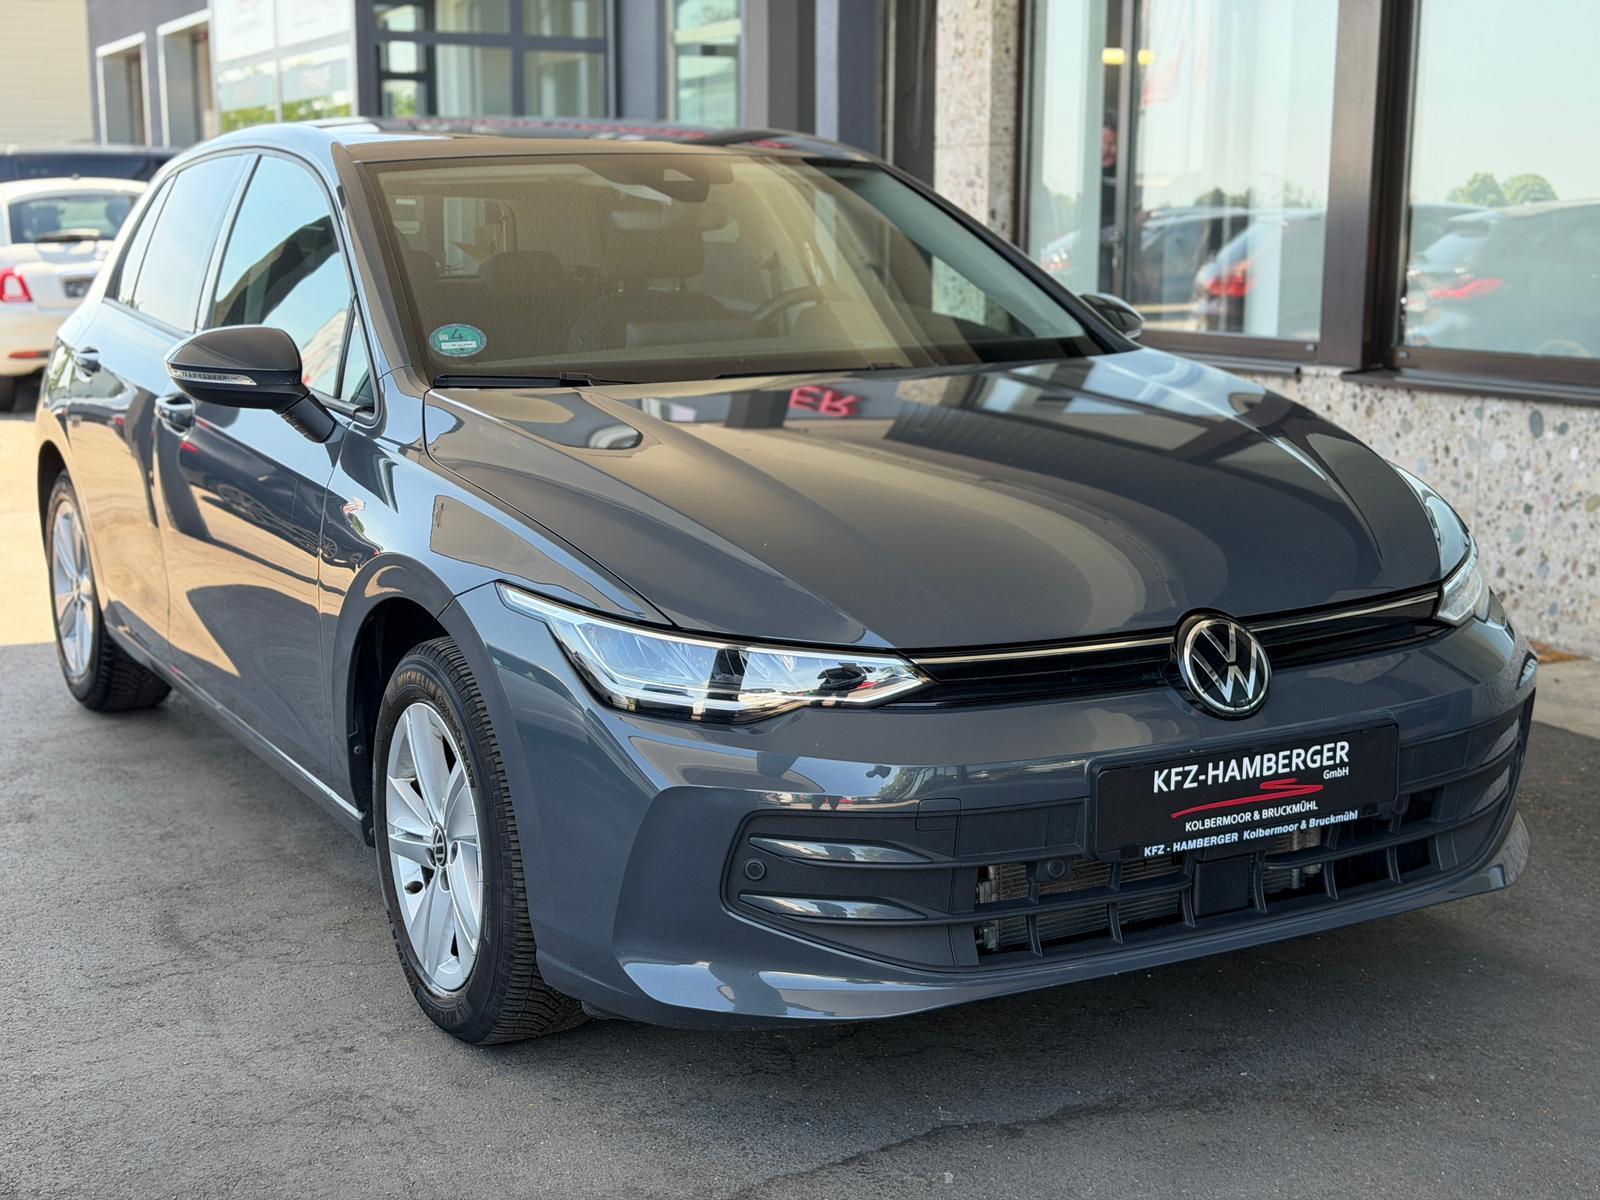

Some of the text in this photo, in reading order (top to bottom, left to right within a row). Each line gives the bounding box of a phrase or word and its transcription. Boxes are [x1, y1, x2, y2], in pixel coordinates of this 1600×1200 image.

[450, 328, 465, 341] 4
[1153, 741, 1350, 793] KFZ-HAMBERGER
[1322, 766, 1349, 780] GmbH
[1185, 800, 1319, 832] KOLBERMOOR & BRUCKMÜHL
[1144, 844, 1165, 857] KFZ
[1172, 832, 1239, 852] HAMBERGER
[1243, 823, 1298, 840] Kolbermoor
[1300, 819, 1307, 830] &
[1308, 810, 1359, 828] Bruckmühl
